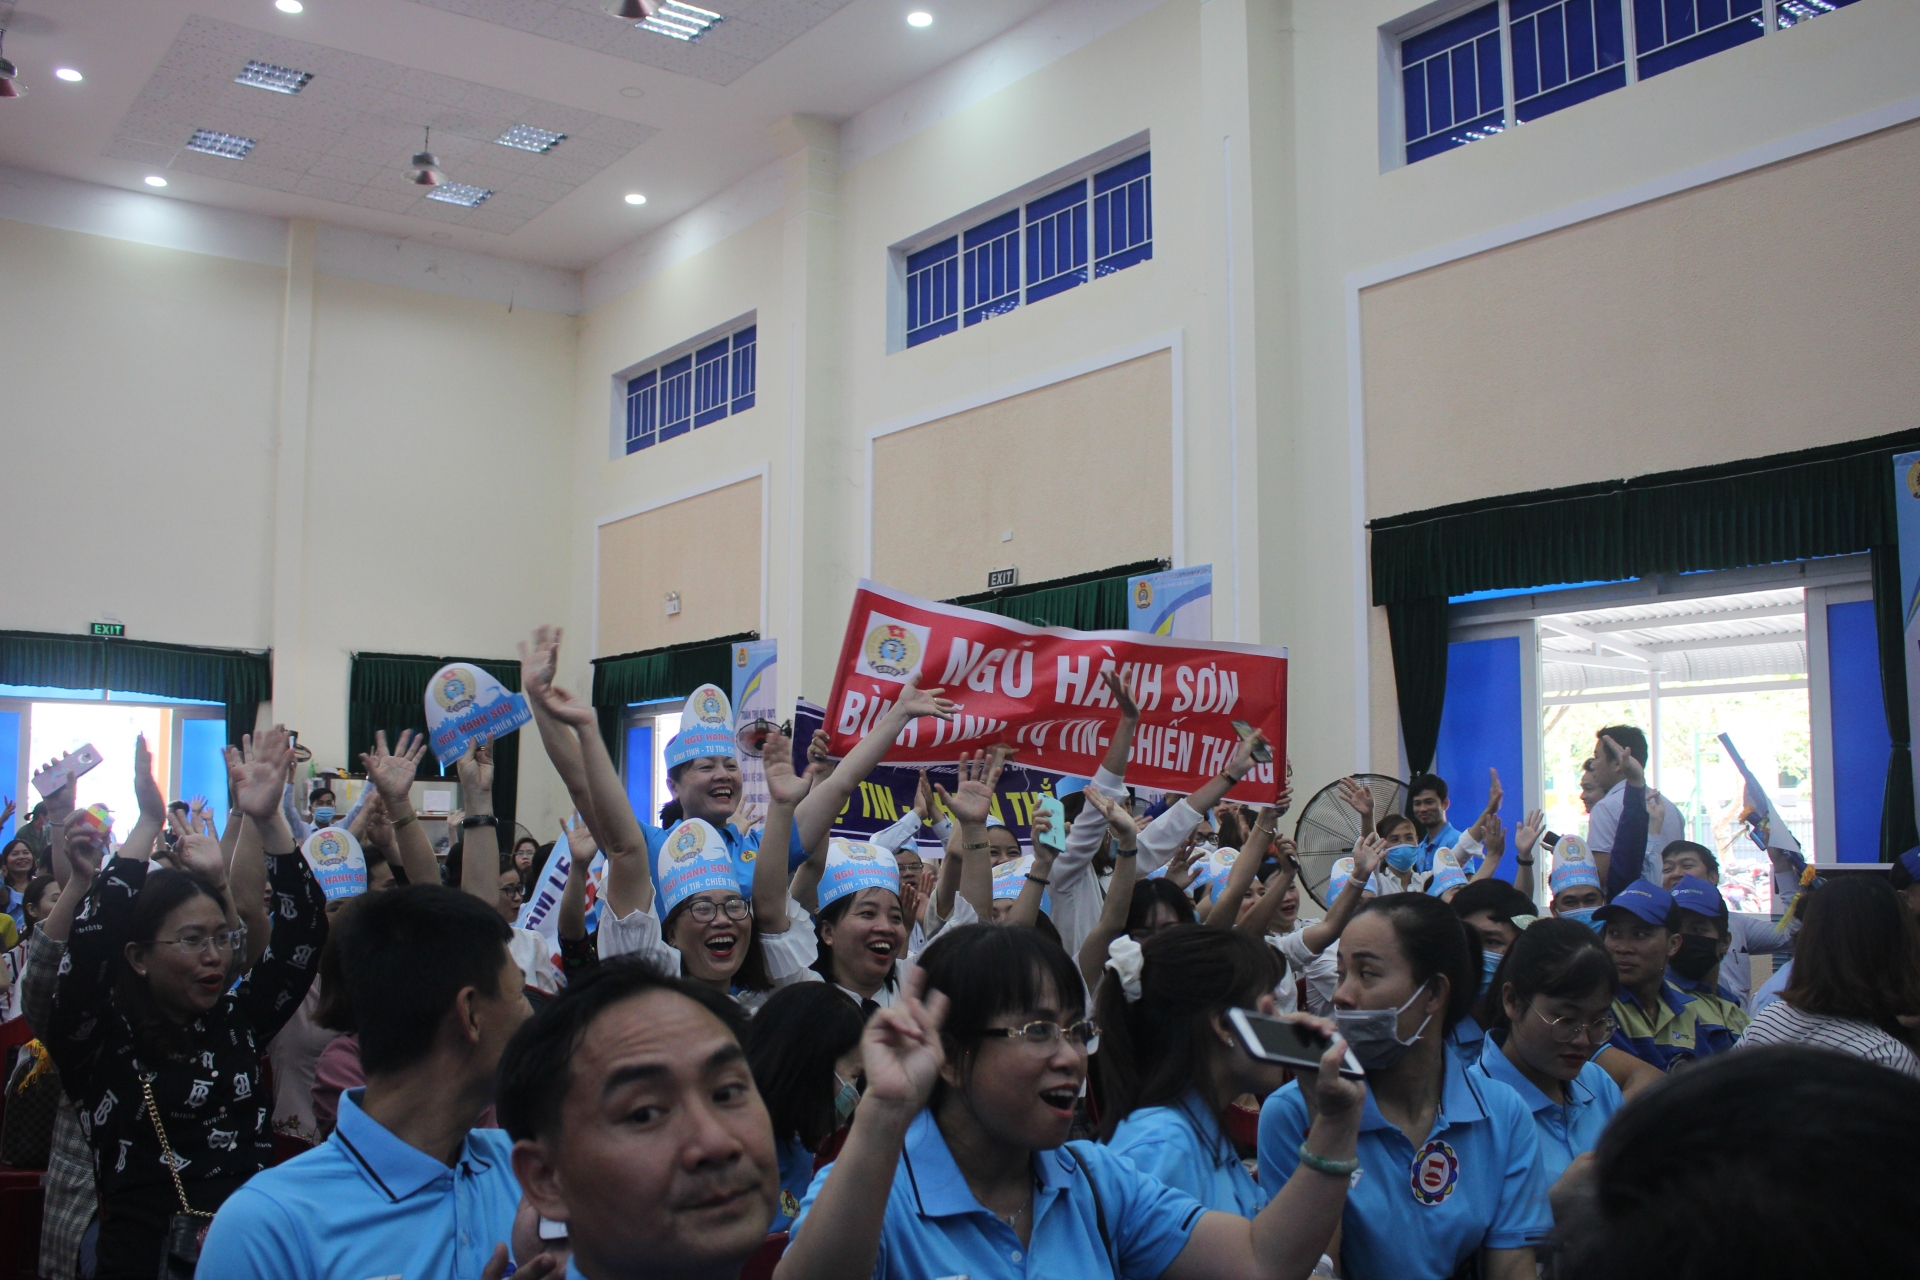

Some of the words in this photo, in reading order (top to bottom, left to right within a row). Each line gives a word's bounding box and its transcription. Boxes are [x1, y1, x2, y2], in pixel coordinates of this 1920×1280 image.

[991, 571, 1012, 585] EXIT
[94, 624, 122, 635] EXIT
[939, 637, 1035, 698] NGŨ
[1055, 645, 1163, 711] HÀNH
[1172, 662, 1239, 715] SƠN
[458, 714, 488, 734] HÀNH
[489, 702, 512, 719] SƠN
[684, 733, 702, 745] NGŨ
[858, 780, 899, 822] TIN
[324, 874, 352, 885] HÀNH
[680, 865, 707, 882] HÀNH
[710, 863, 730, 873] SƠN
[833, 868, 855, 881] NGŨ
[857, 867, 883, 876] HÀNH
